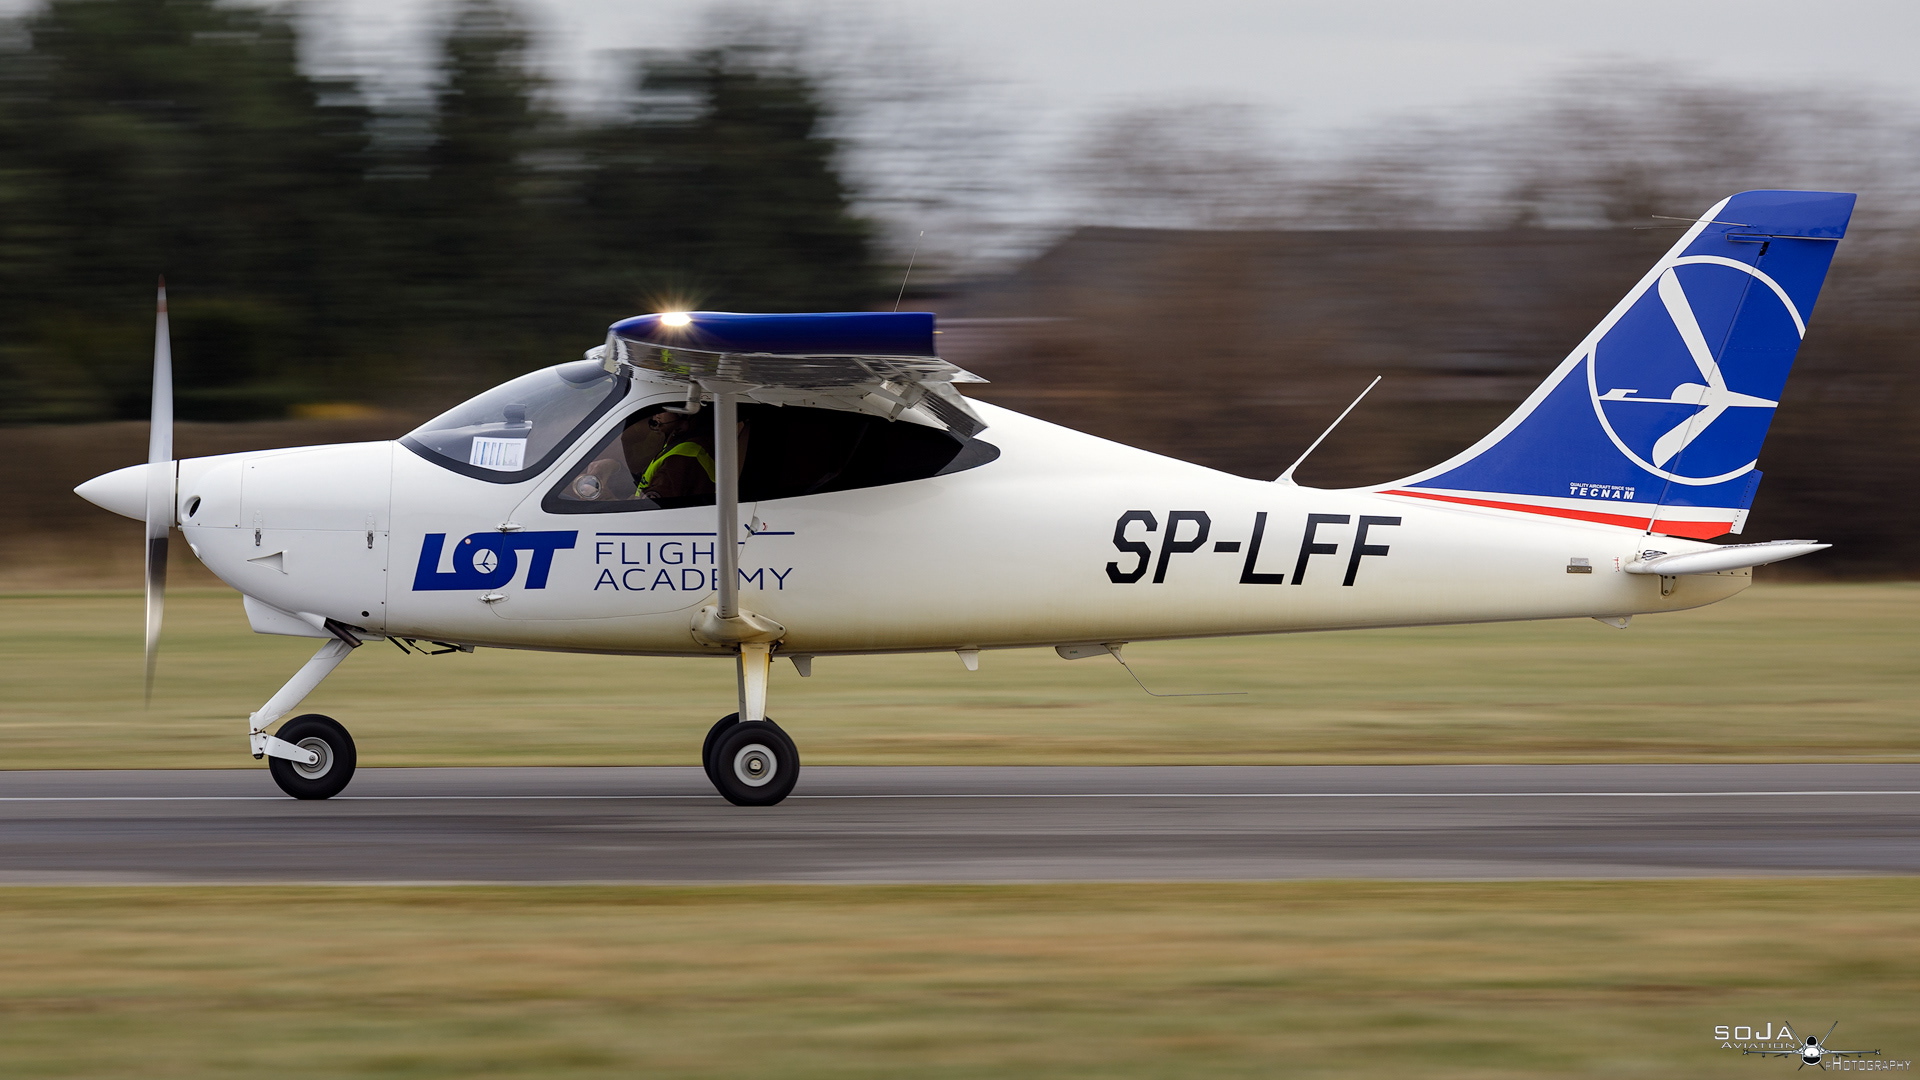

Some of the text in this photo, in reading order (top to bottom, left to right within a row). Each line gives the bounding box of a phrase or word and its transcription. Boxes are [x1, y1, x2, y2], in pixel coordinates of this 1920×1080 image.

[1570, 487, 1635, 500] TECNAM
[412, 530, 579, 591] LOT
[1105, 510, 1402, 586] SP-LFF
